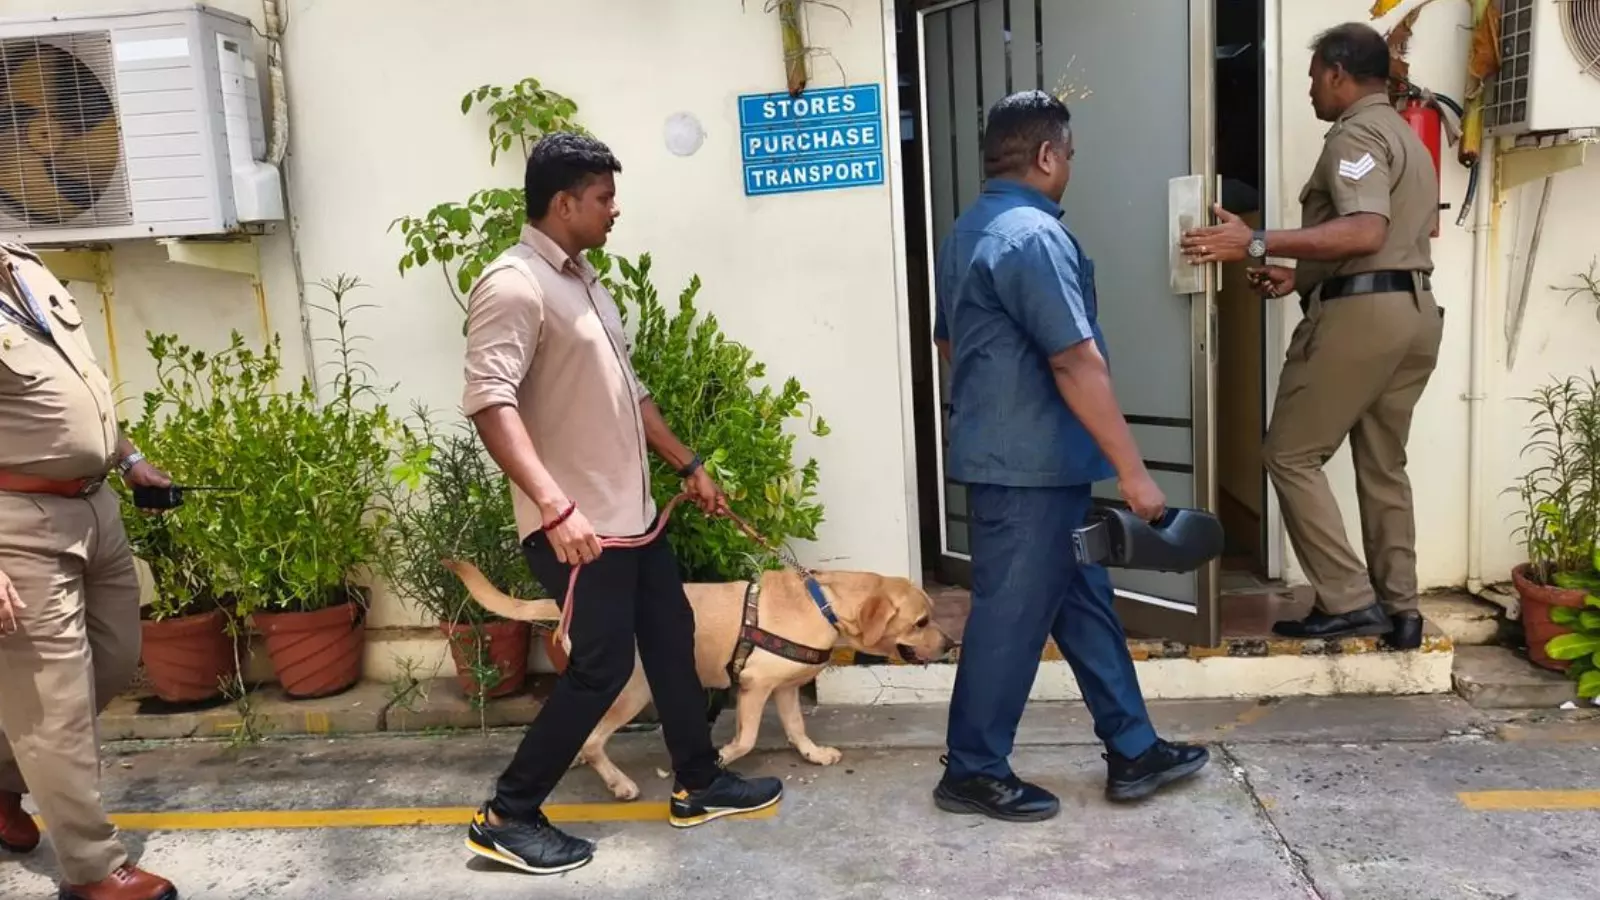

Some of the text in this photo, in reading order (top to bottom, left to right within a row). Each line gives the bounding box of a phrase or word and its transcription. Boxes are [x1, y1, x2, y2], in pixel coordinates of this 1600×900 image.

[762, 94, 856, 119] STORES
[749, 126, 875, 155] PURCHASE
[751, 160, 877, 188] TRANSPORT
